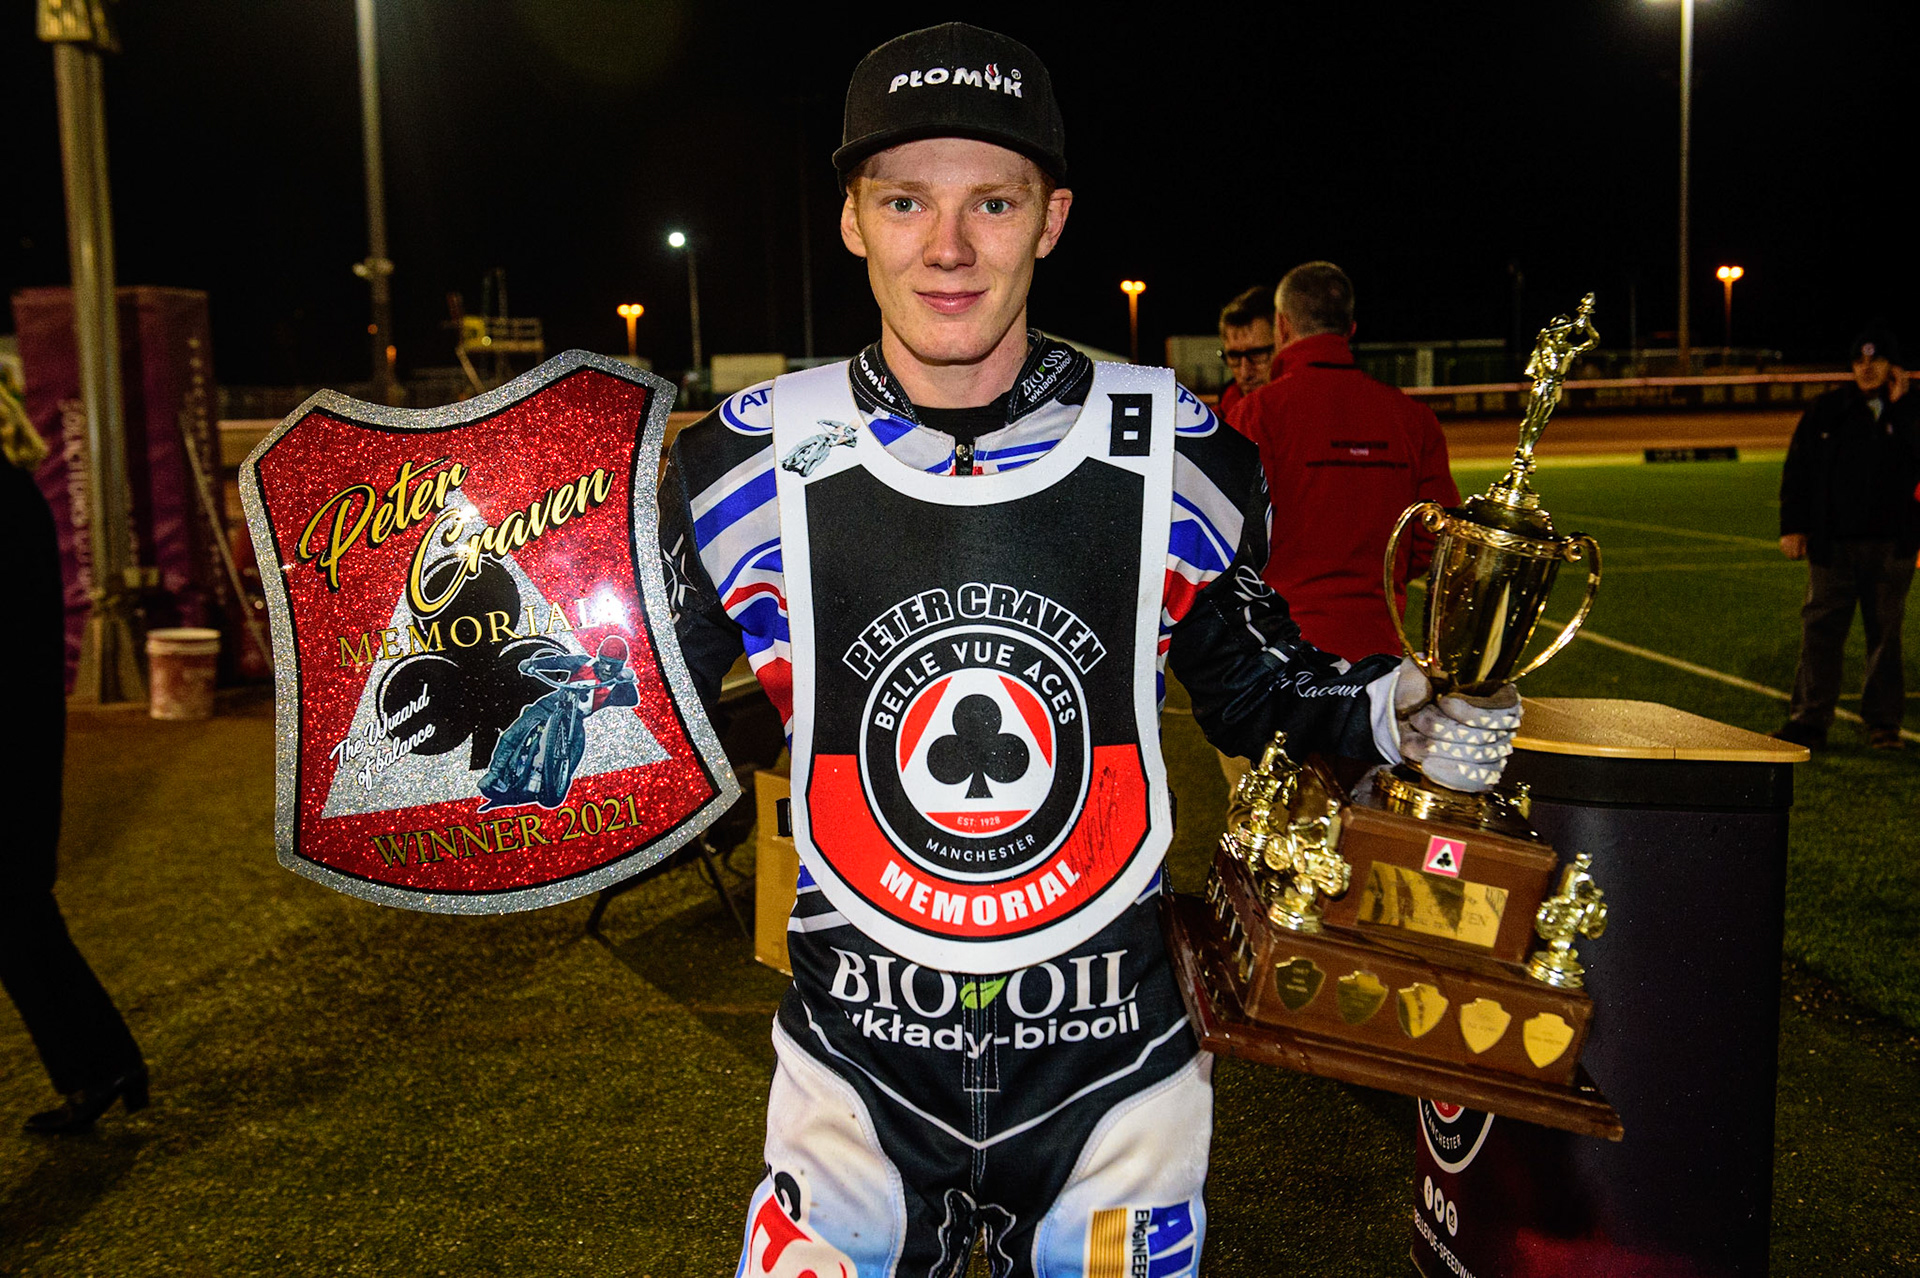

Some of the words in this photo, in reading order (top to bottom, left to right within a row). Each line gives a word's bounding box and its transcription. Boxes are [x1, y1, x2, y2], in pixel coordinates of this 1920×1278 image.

[1107, 393, 1152, 457] 8
[297, 456, 468, 592] Peter
[407, 466, 616, 618] Craven
[337, 597, 601, 667] MEMORIAL
[842, 587, 955, 681] PETER
[957, 582, 1107, 675] CRAVEN
[874, 652, 941, 731] BELLE
[951, 641, 1015, 668] VUE
[1023, 660, 1077, 725] ACES
[329, 737, 366, 769] The
[363, 683, 431, 745] Wizard
[356, 761, 375, 792] of
[375, 722, 437, 771] balance
[371, 813, 551, 868] WINNER
[556, 793, 644, 842] 2021
[926, 833, 1036, 862] MANCHESTER
[879, 858, 1081, 927] MEMORIAL
[828, 946, 957, 1019] BIO
[1006, 949, 1140, 1020] OIL
